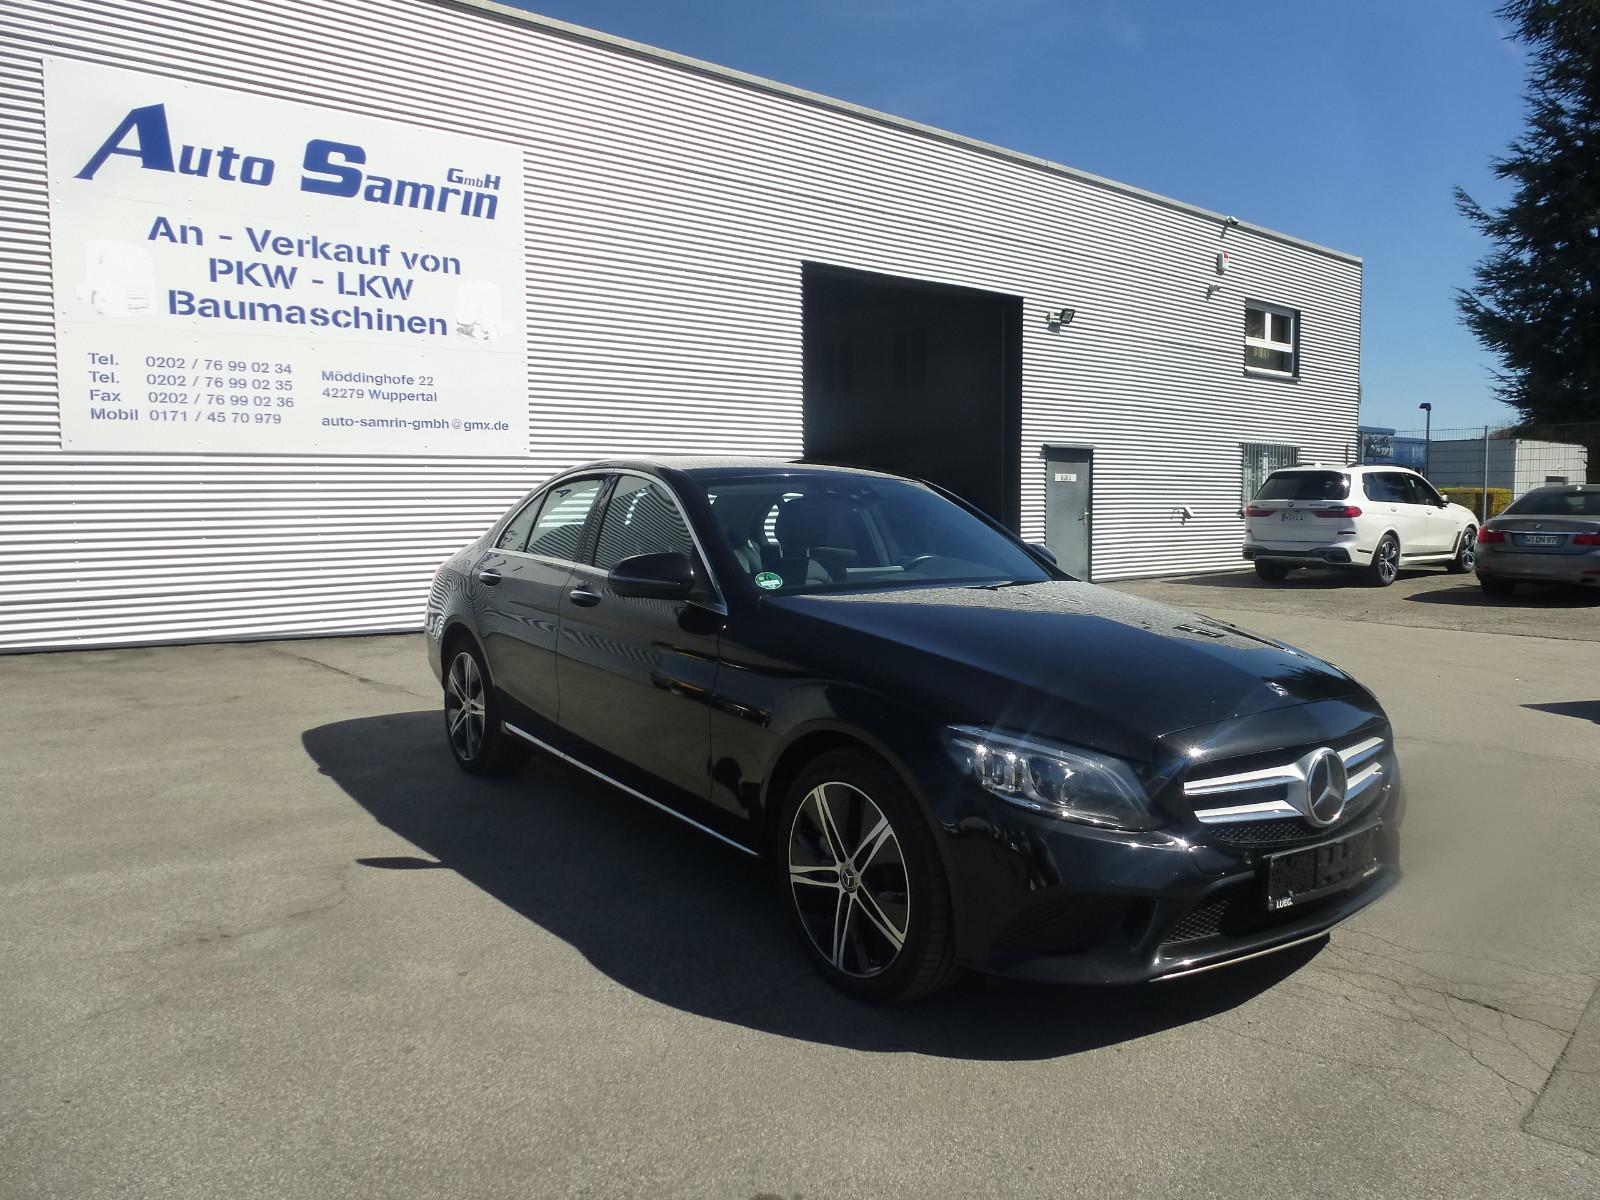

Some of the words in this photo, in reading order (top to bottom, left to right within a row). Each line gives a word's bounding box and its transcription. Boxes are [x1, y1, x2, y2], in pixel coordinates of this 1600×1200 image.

[72, 103, 275, 187] Auto
[300, 138, 499, 220] Samrin
[446, 167, 502, 191] GmbH
[147, 216, 204, 246] An
[245, 226, 391, 267] Verkauf
[400, 250, 461, 275] von
[208, 256, 299, 290] PKW
[337, 271, 415, 301] LKW
[168, 288, 448, 337] Baumaschinen
[87, 352, 119, 366] Tel.
[145, 355, 187, 370] 0202
[204, 359, 224, 371] 76
[227, 360, 248, 372] 99
[251, 361, 271, 374] 02
[274, 363, 293, 375] 34
[88, 371, 120, 384] Tel.
[147, 373, 187, 387] 0202
[205, 377, 224, 388] 76
[228, 378, 248, 389] 99
[252, 379, 271, 390] 02
[275, 380, 294, 392] 35
[321, 370, 416, 387] Möddinghofe
[418, 376, 435, 387] 22
[89, 389, 122, 402] Fax
[148, 391, 188, 405] 0202
[206, 394, 226, 406] 76
[230, 395, 249, 407] 99
[253, 396, 272, 408] 02
[276, 397, 295, 409] 36
[321, 387, 365, 399] 42279
[367, 389, 438, 403] Wuppertal
[90, 408, 139, 421] Mobil
[149, 409, 188, 422] 0171
[207, 412, 227, 423] 45
[231, 413, 250, 424] 70
[254, 413, 283, 425] 979
